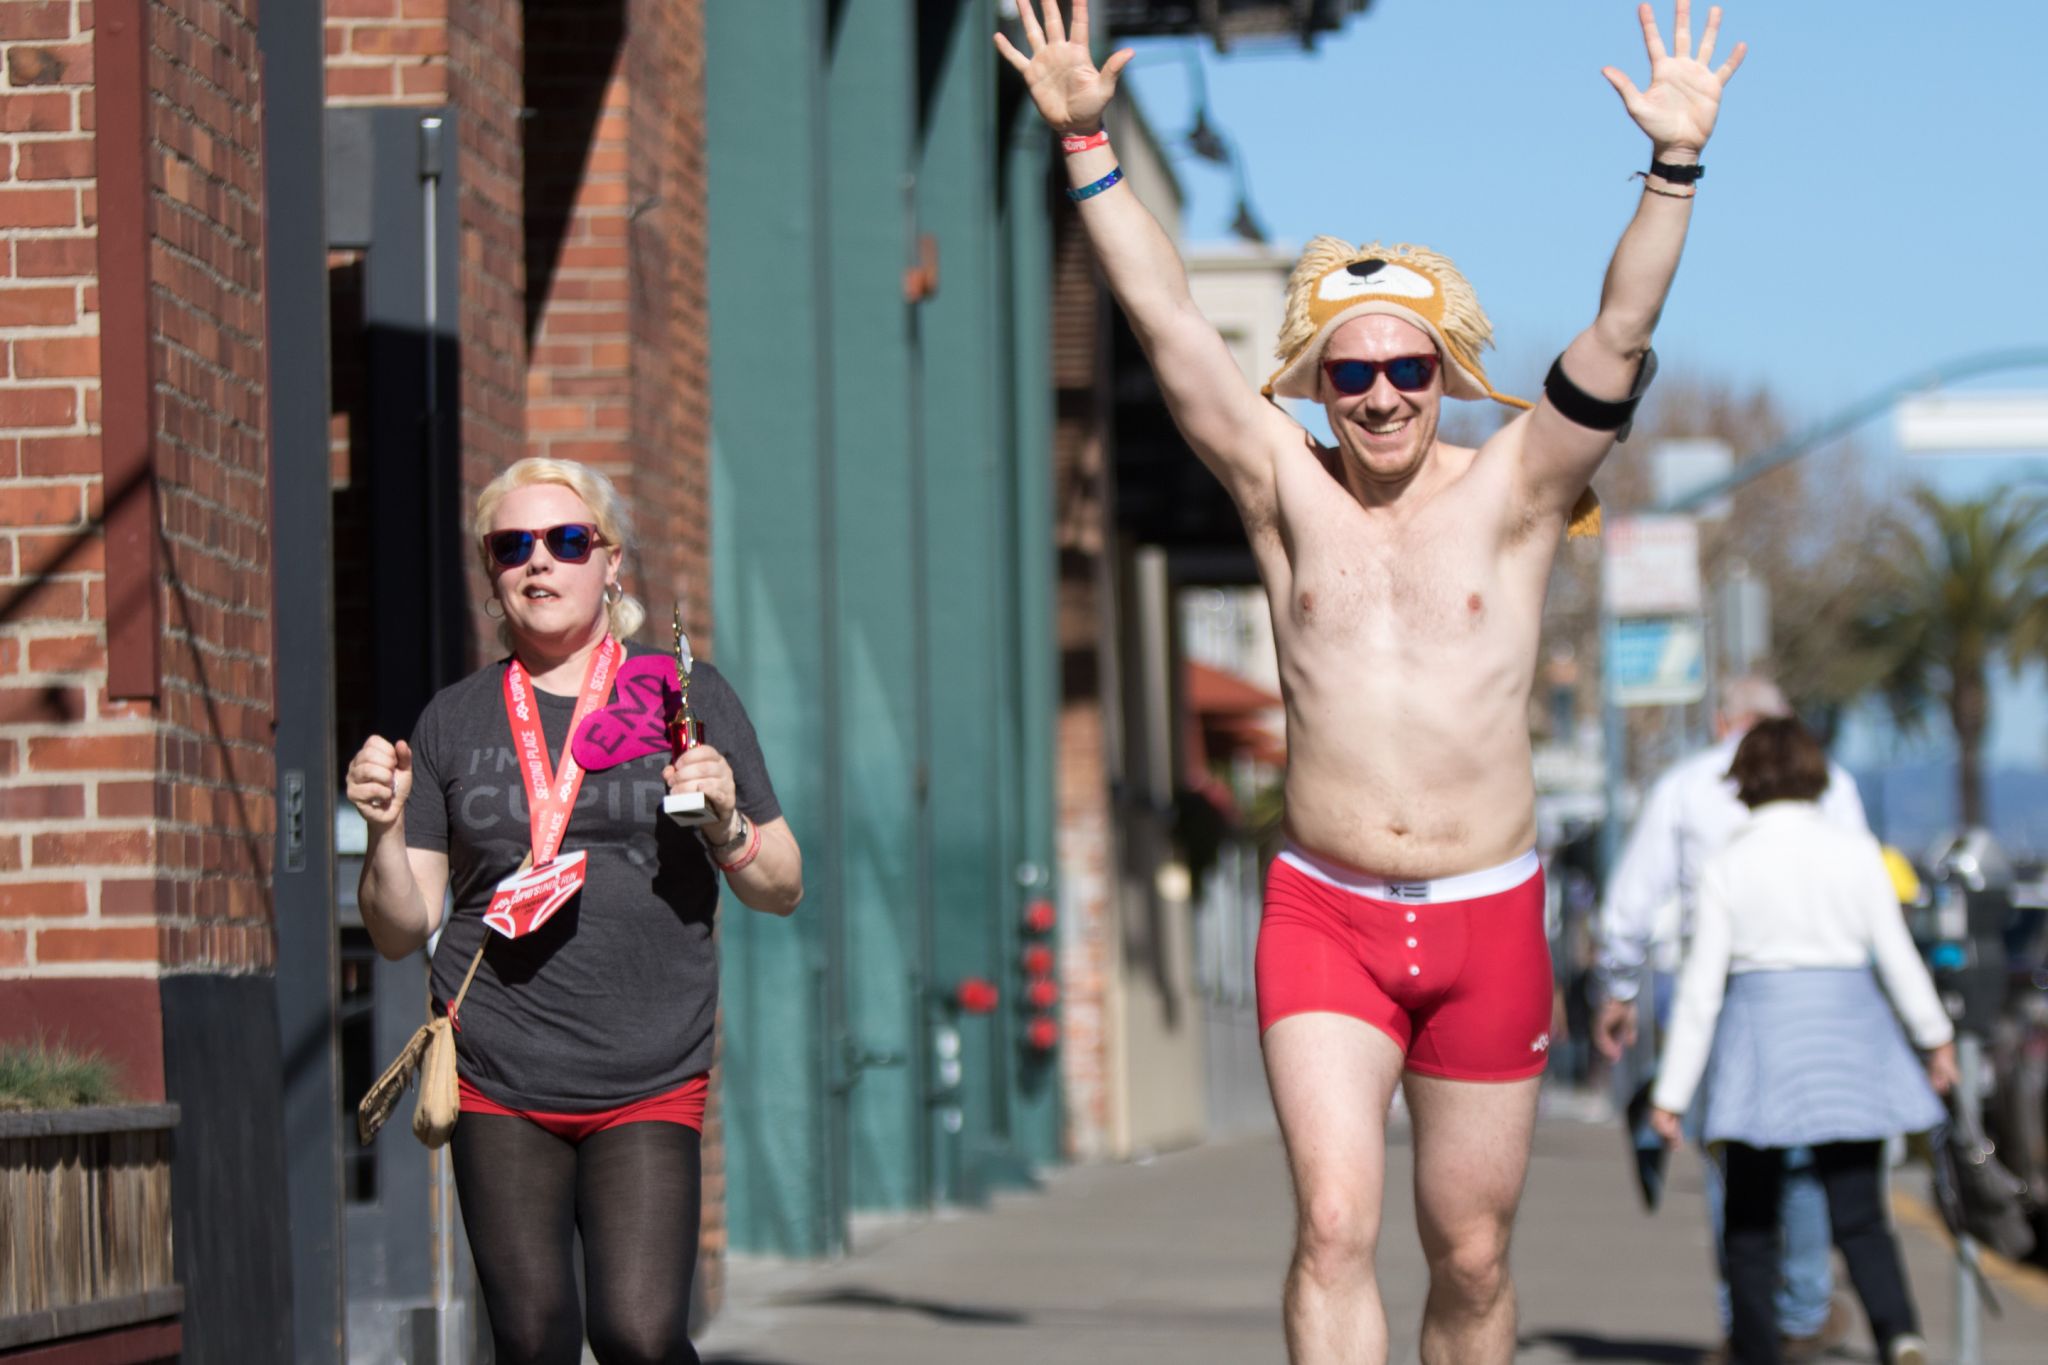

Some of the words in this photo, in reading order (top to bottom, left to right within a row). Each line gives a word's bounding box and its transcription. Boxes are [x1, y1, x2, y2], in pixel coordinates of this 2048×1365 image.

[590, 653, 611, 692] SECOND
[584, 674, 664, 756] END
[521, 730, 540, 761] PLACE
[528, 761, 549, 800] SECOND
[461, 780, 666, 830] CUPID
[545, 812, 565, 844] PLACE
